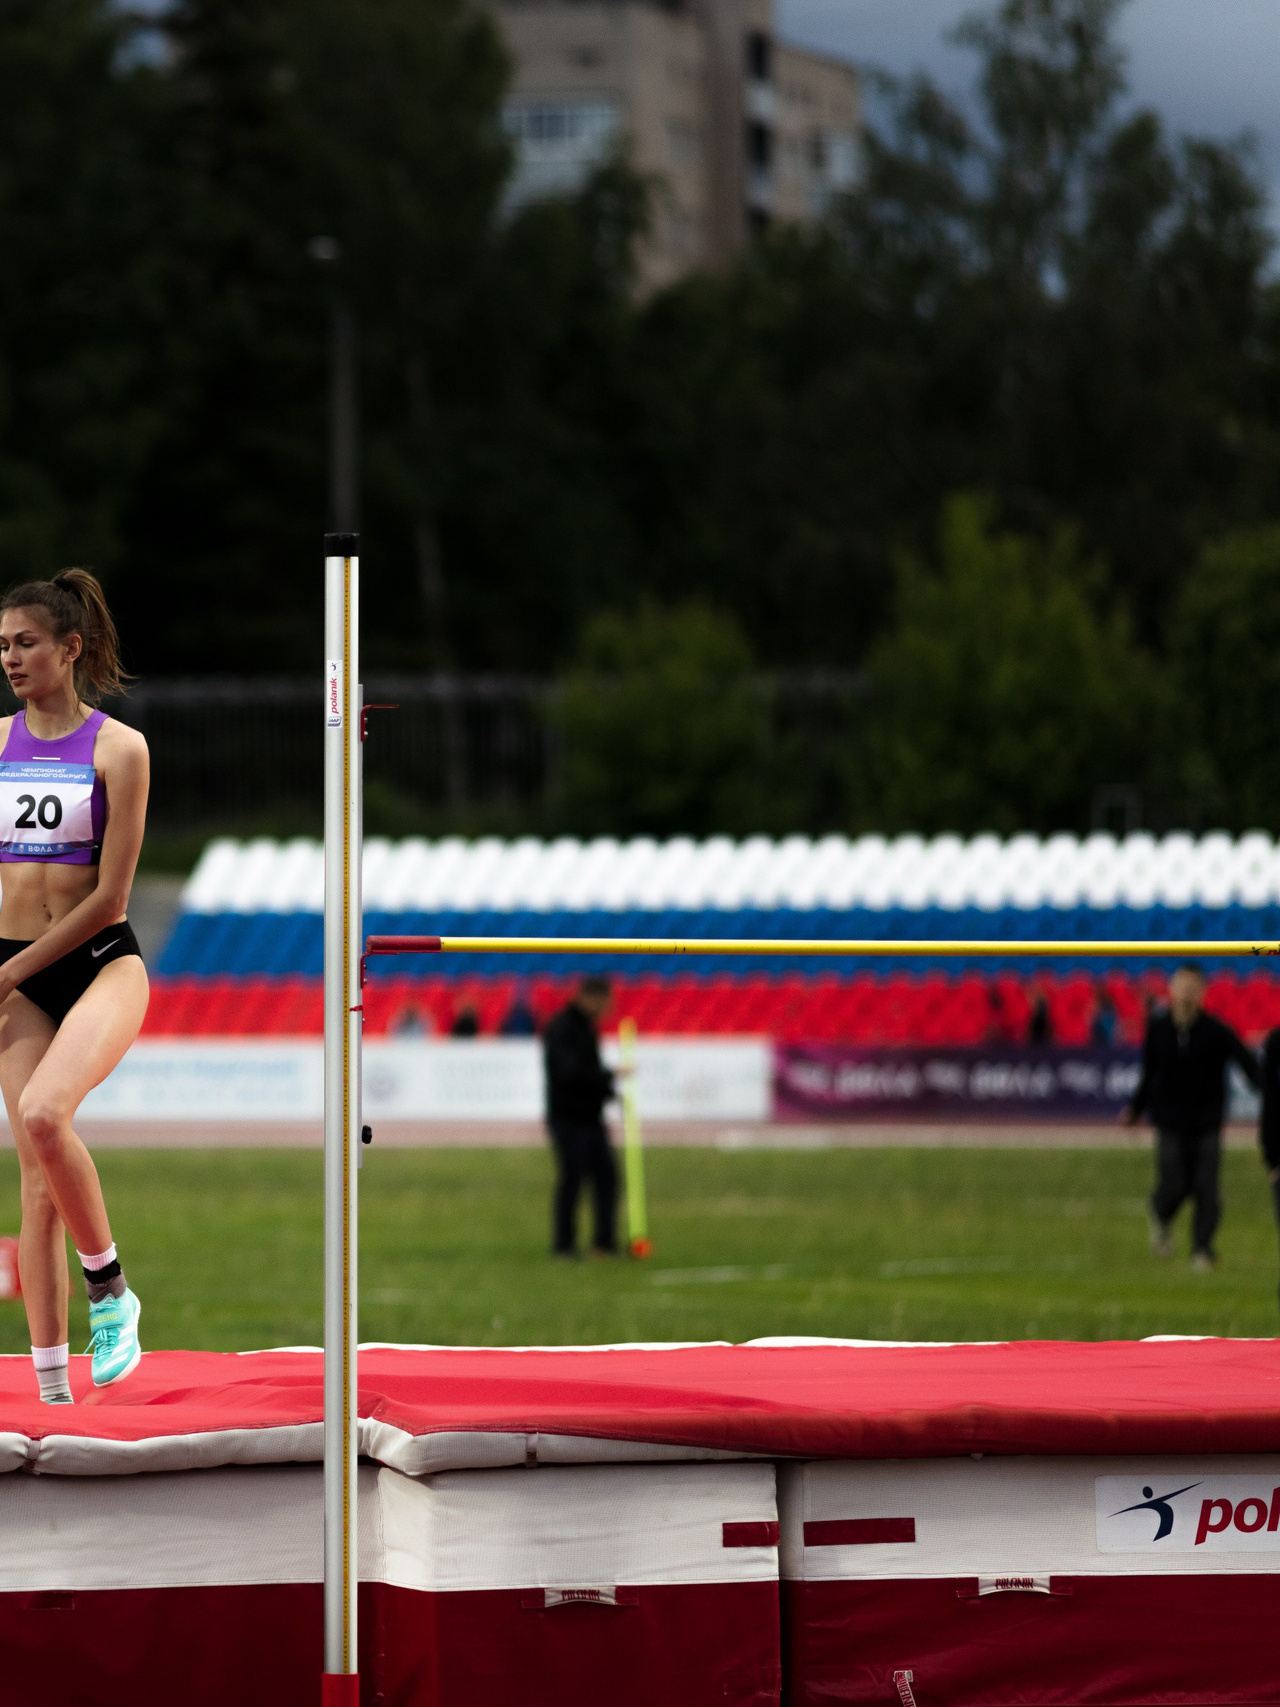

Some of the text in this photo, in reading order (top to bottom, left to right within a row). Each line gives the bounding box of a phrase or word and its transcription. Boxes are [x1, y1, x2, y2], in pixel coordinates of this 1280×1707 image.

[330, 678, 339, 714] polanik
[15, 794, 63, 830] 20
[28, 845, 53, 853] ВФЛА
[995, 1578, 1034, 1590] POLANIK
